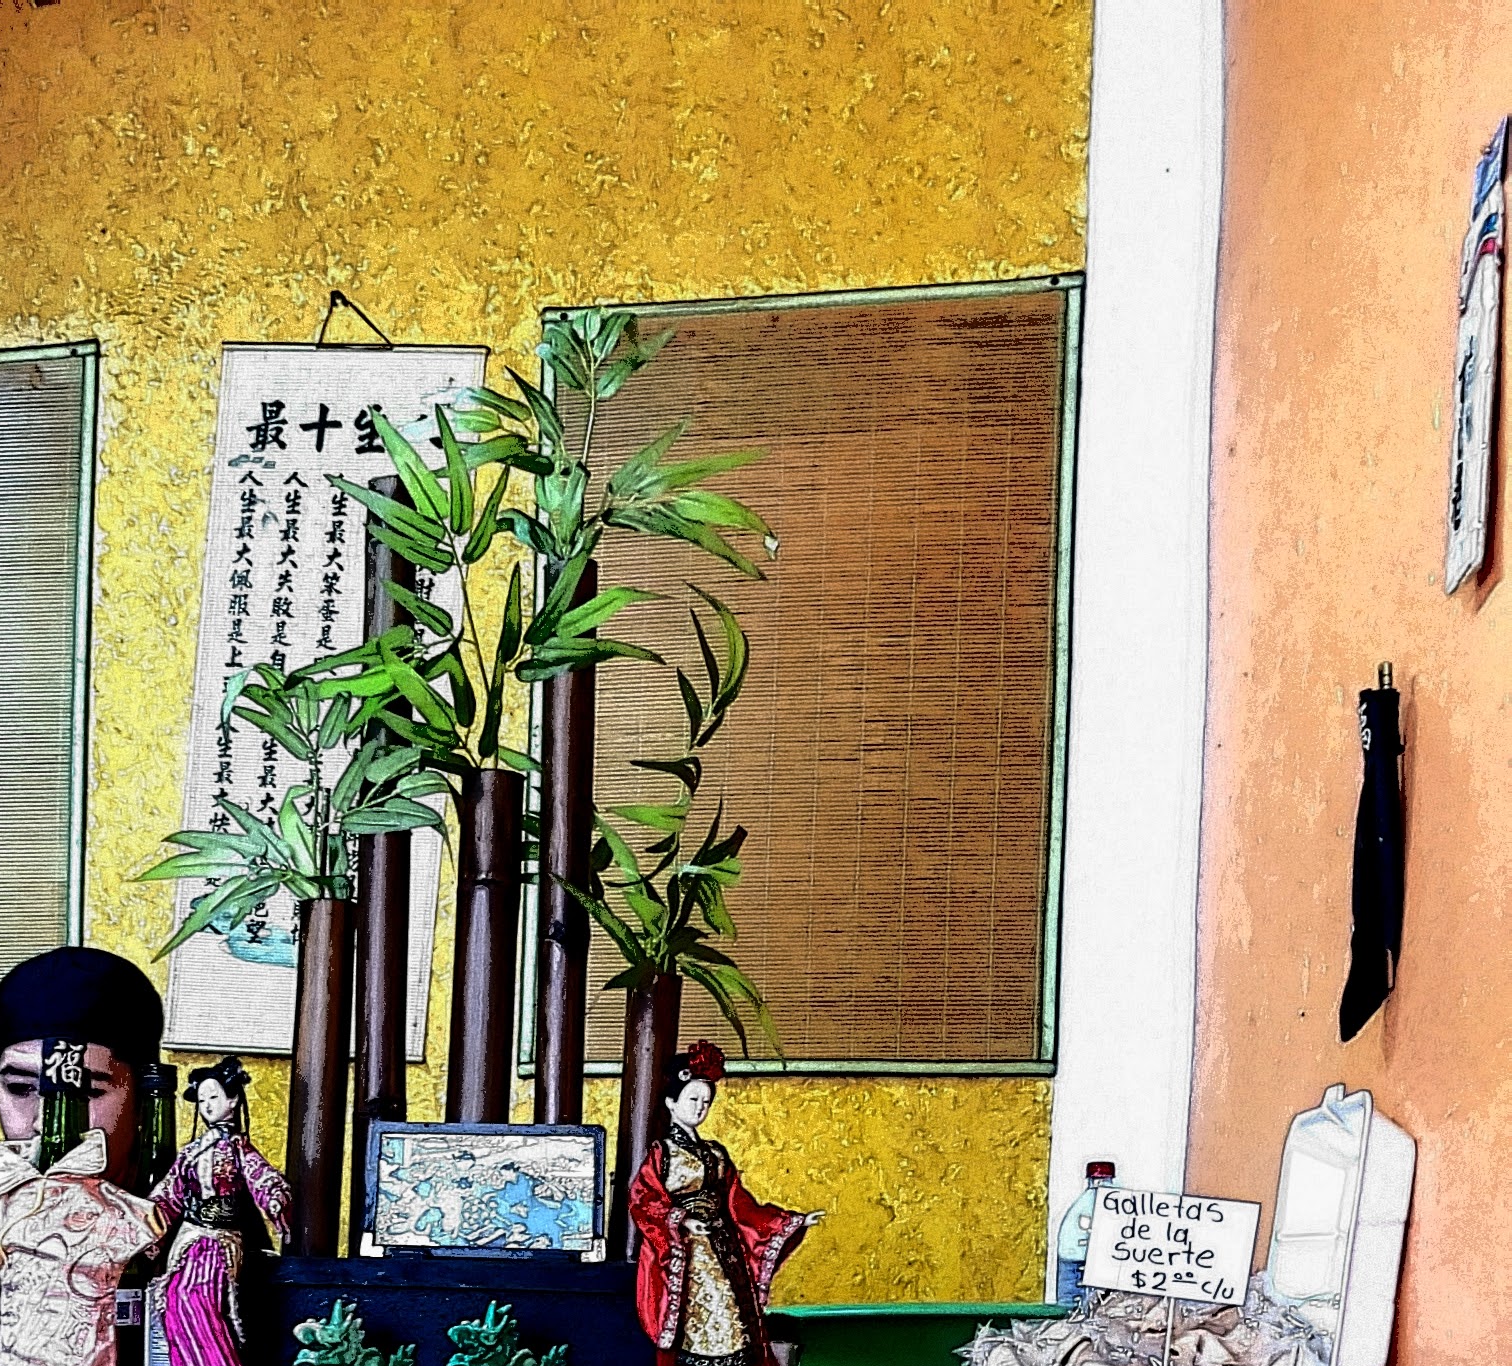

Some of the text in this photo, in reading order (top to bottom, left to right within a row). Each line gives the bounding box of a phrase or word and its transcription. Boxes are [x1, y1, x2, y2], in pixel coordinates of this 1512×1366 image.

[45, 1040, 85, 1088] 福
[1103, 1190, 1224, 1222] Galletas
[1121, 1217, 1190, 1246] de la
[1112, 1241, 1215, 1269] Suerte
[1201, 1277, 1235, 1300] c/u
